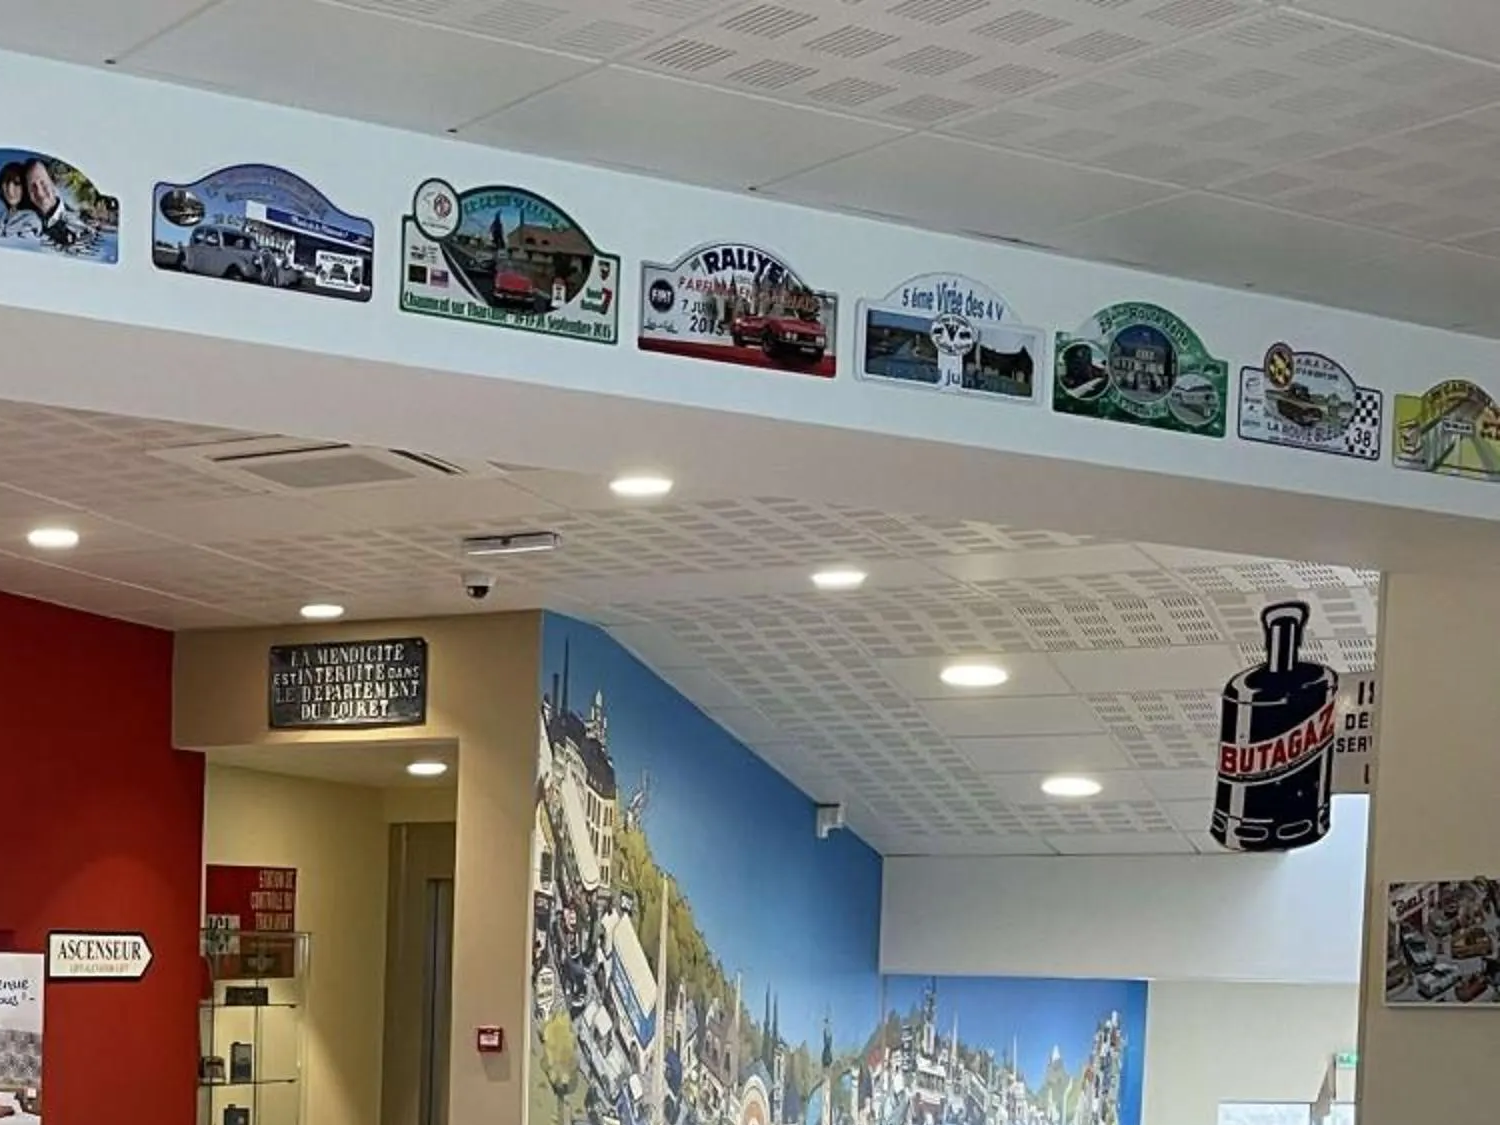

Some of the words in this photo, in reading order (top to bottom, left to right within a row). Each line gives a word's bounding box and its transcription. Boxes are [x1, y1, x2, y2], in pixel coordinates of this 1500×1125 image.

[703, 247, 785, 285] RALLYE
[651, 289, 671, 303] FIAT
[902, 288, 910, 307] 5
[964, 290, 984, 319] des
[1353, 427, 1371, 448] 38
[291, 651, 311, 668] LA
[316, 643, 405, 666] MENDICITE
[273, 672, 297, 687] EST
[297, 663, 385, 685] INTERDITE
[302, 680, 420, 703] DEPARTEMENT
[300, 702, 321, 721] DU
[330, 700, 389, 719] LOIRET
[1345, 712, 1372, 731] DE
[1220, 703, 1335, 774] BUTAGAZ
[1335, 736, 1372, 753] SER
[57, 939, 142, 961] ASCENSEUR
